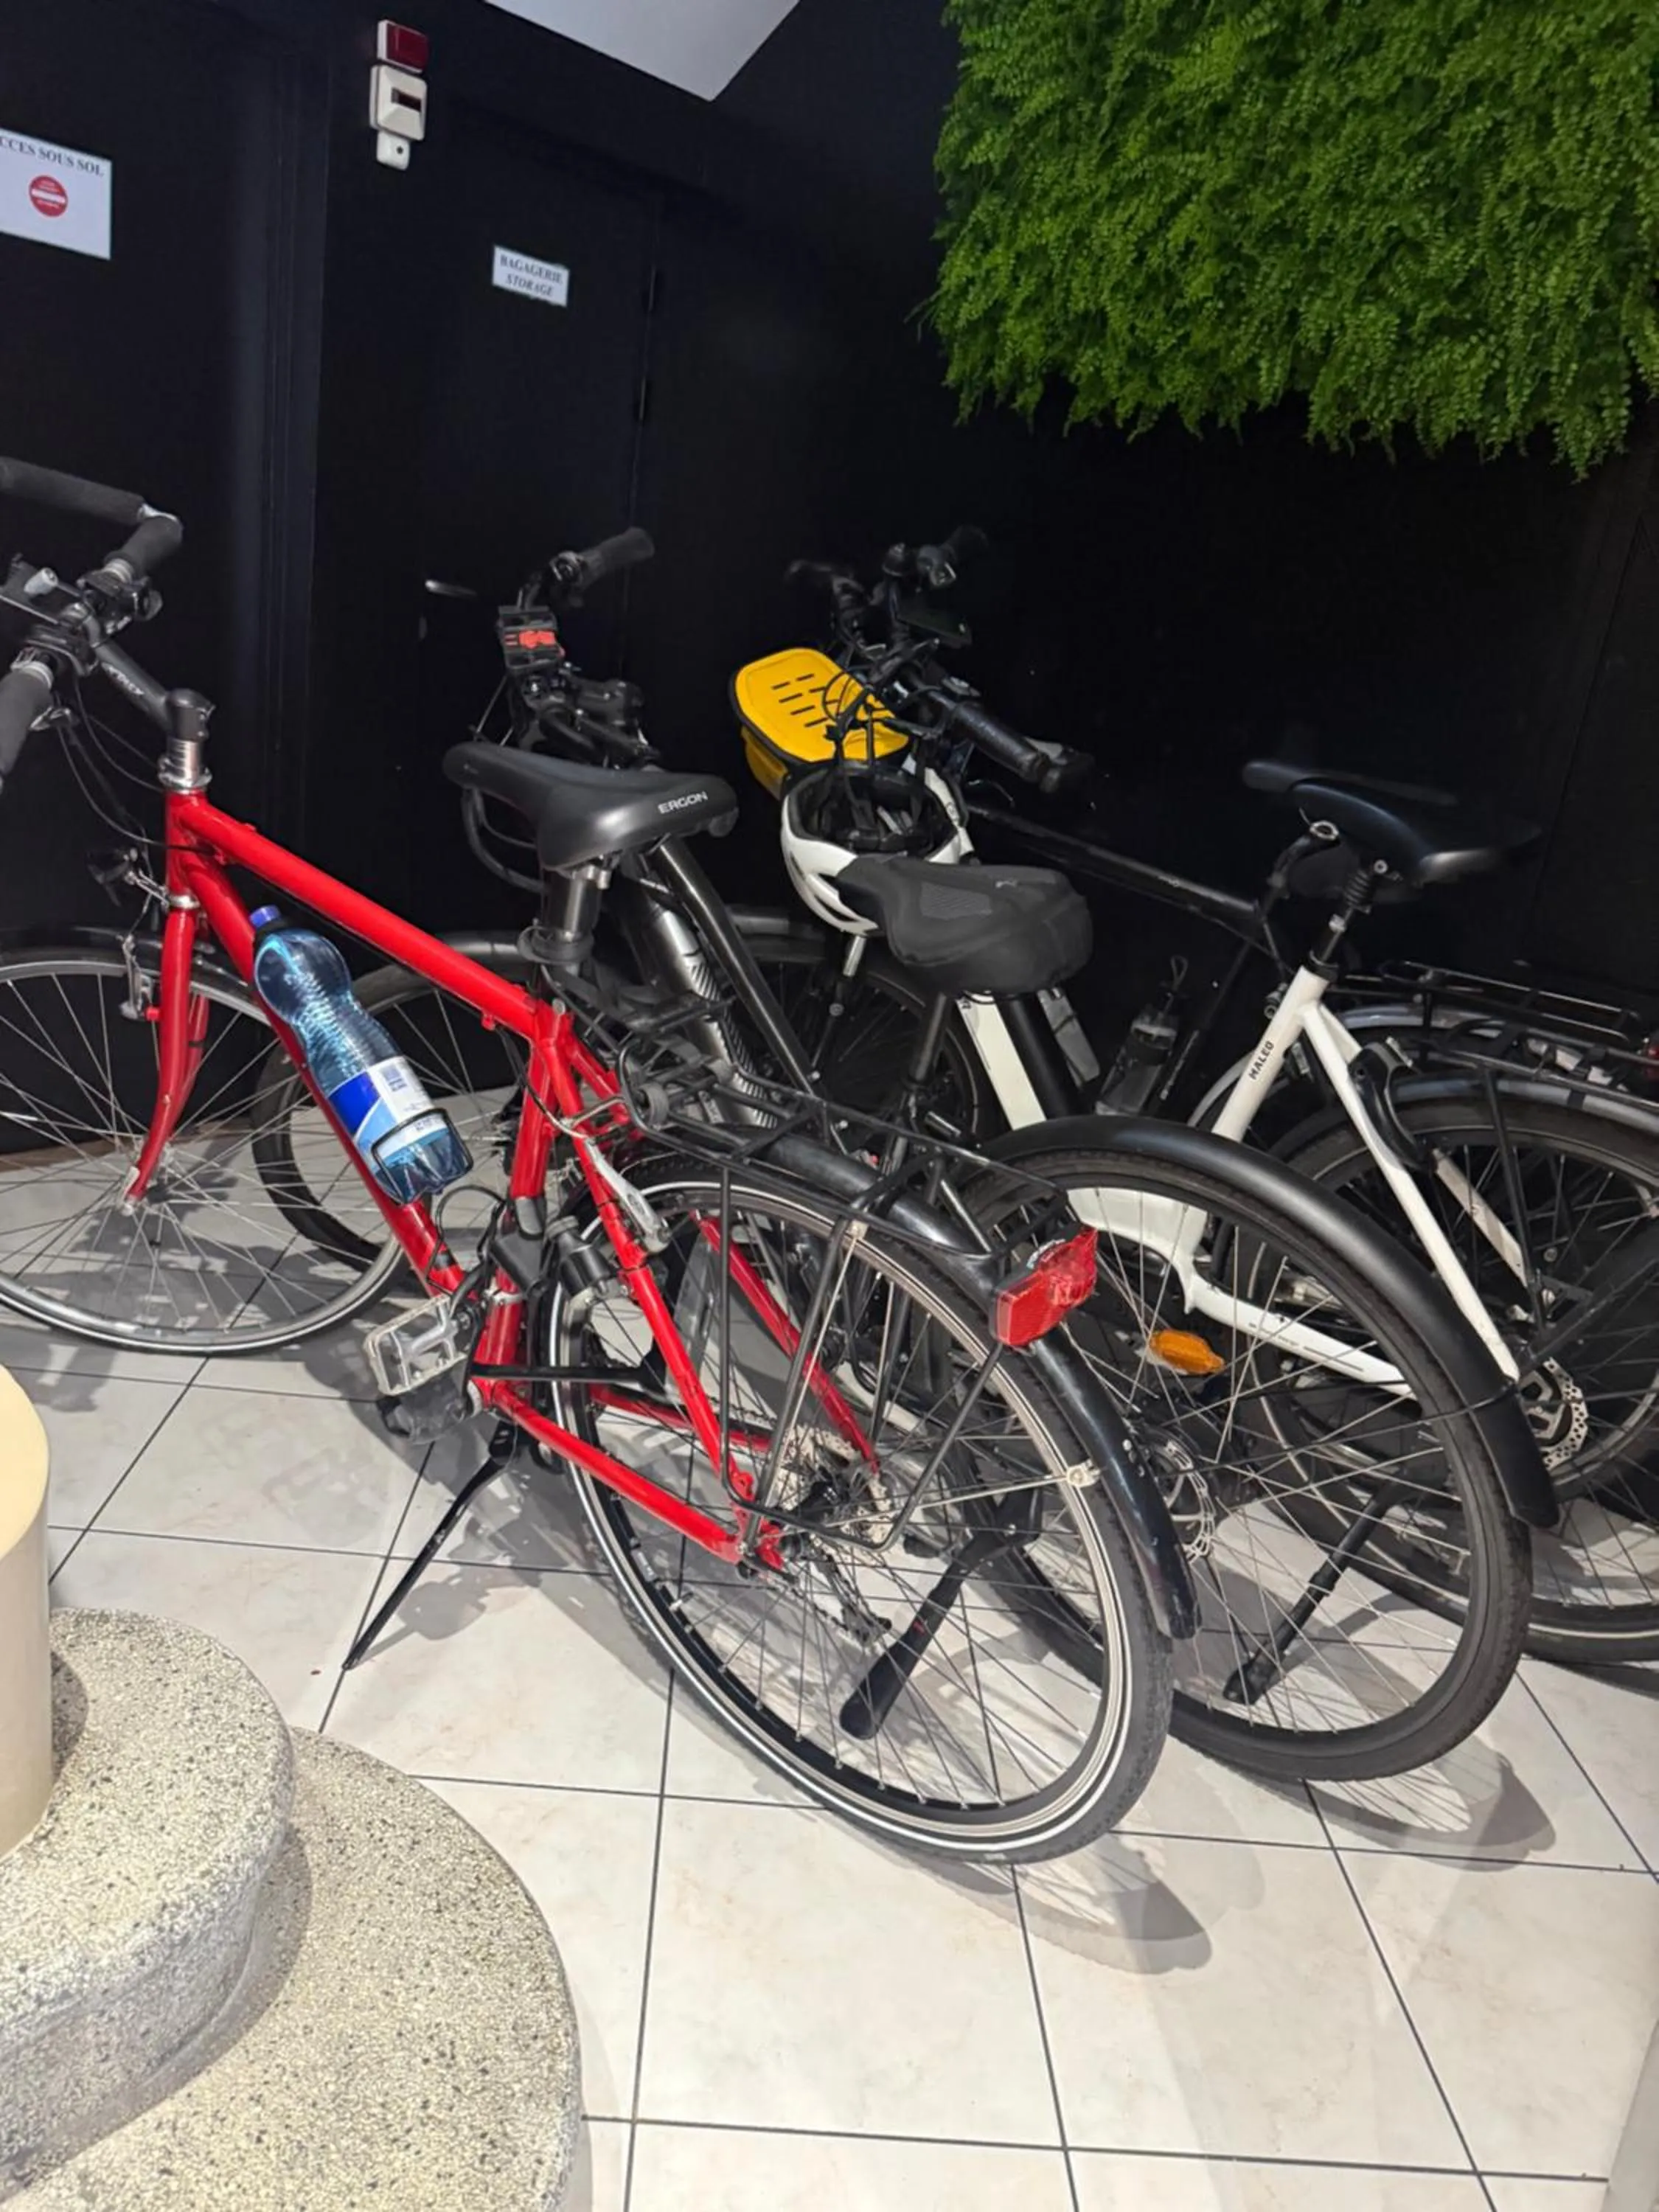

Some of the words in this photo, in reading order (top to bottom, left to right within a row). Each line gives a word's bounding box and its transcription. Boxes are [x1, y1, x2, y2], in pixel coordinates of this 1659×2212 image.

[38, 147, 74, 167] SOUS
[77, 159, 105, 177] SOL
[500, 254, 563, 284] BAGAGERIE
[507, 274, 552, 296] STORAGE
[658, 790, 708, 814] ERGON
[1248, 1040, 1274, 1081] MALEO
